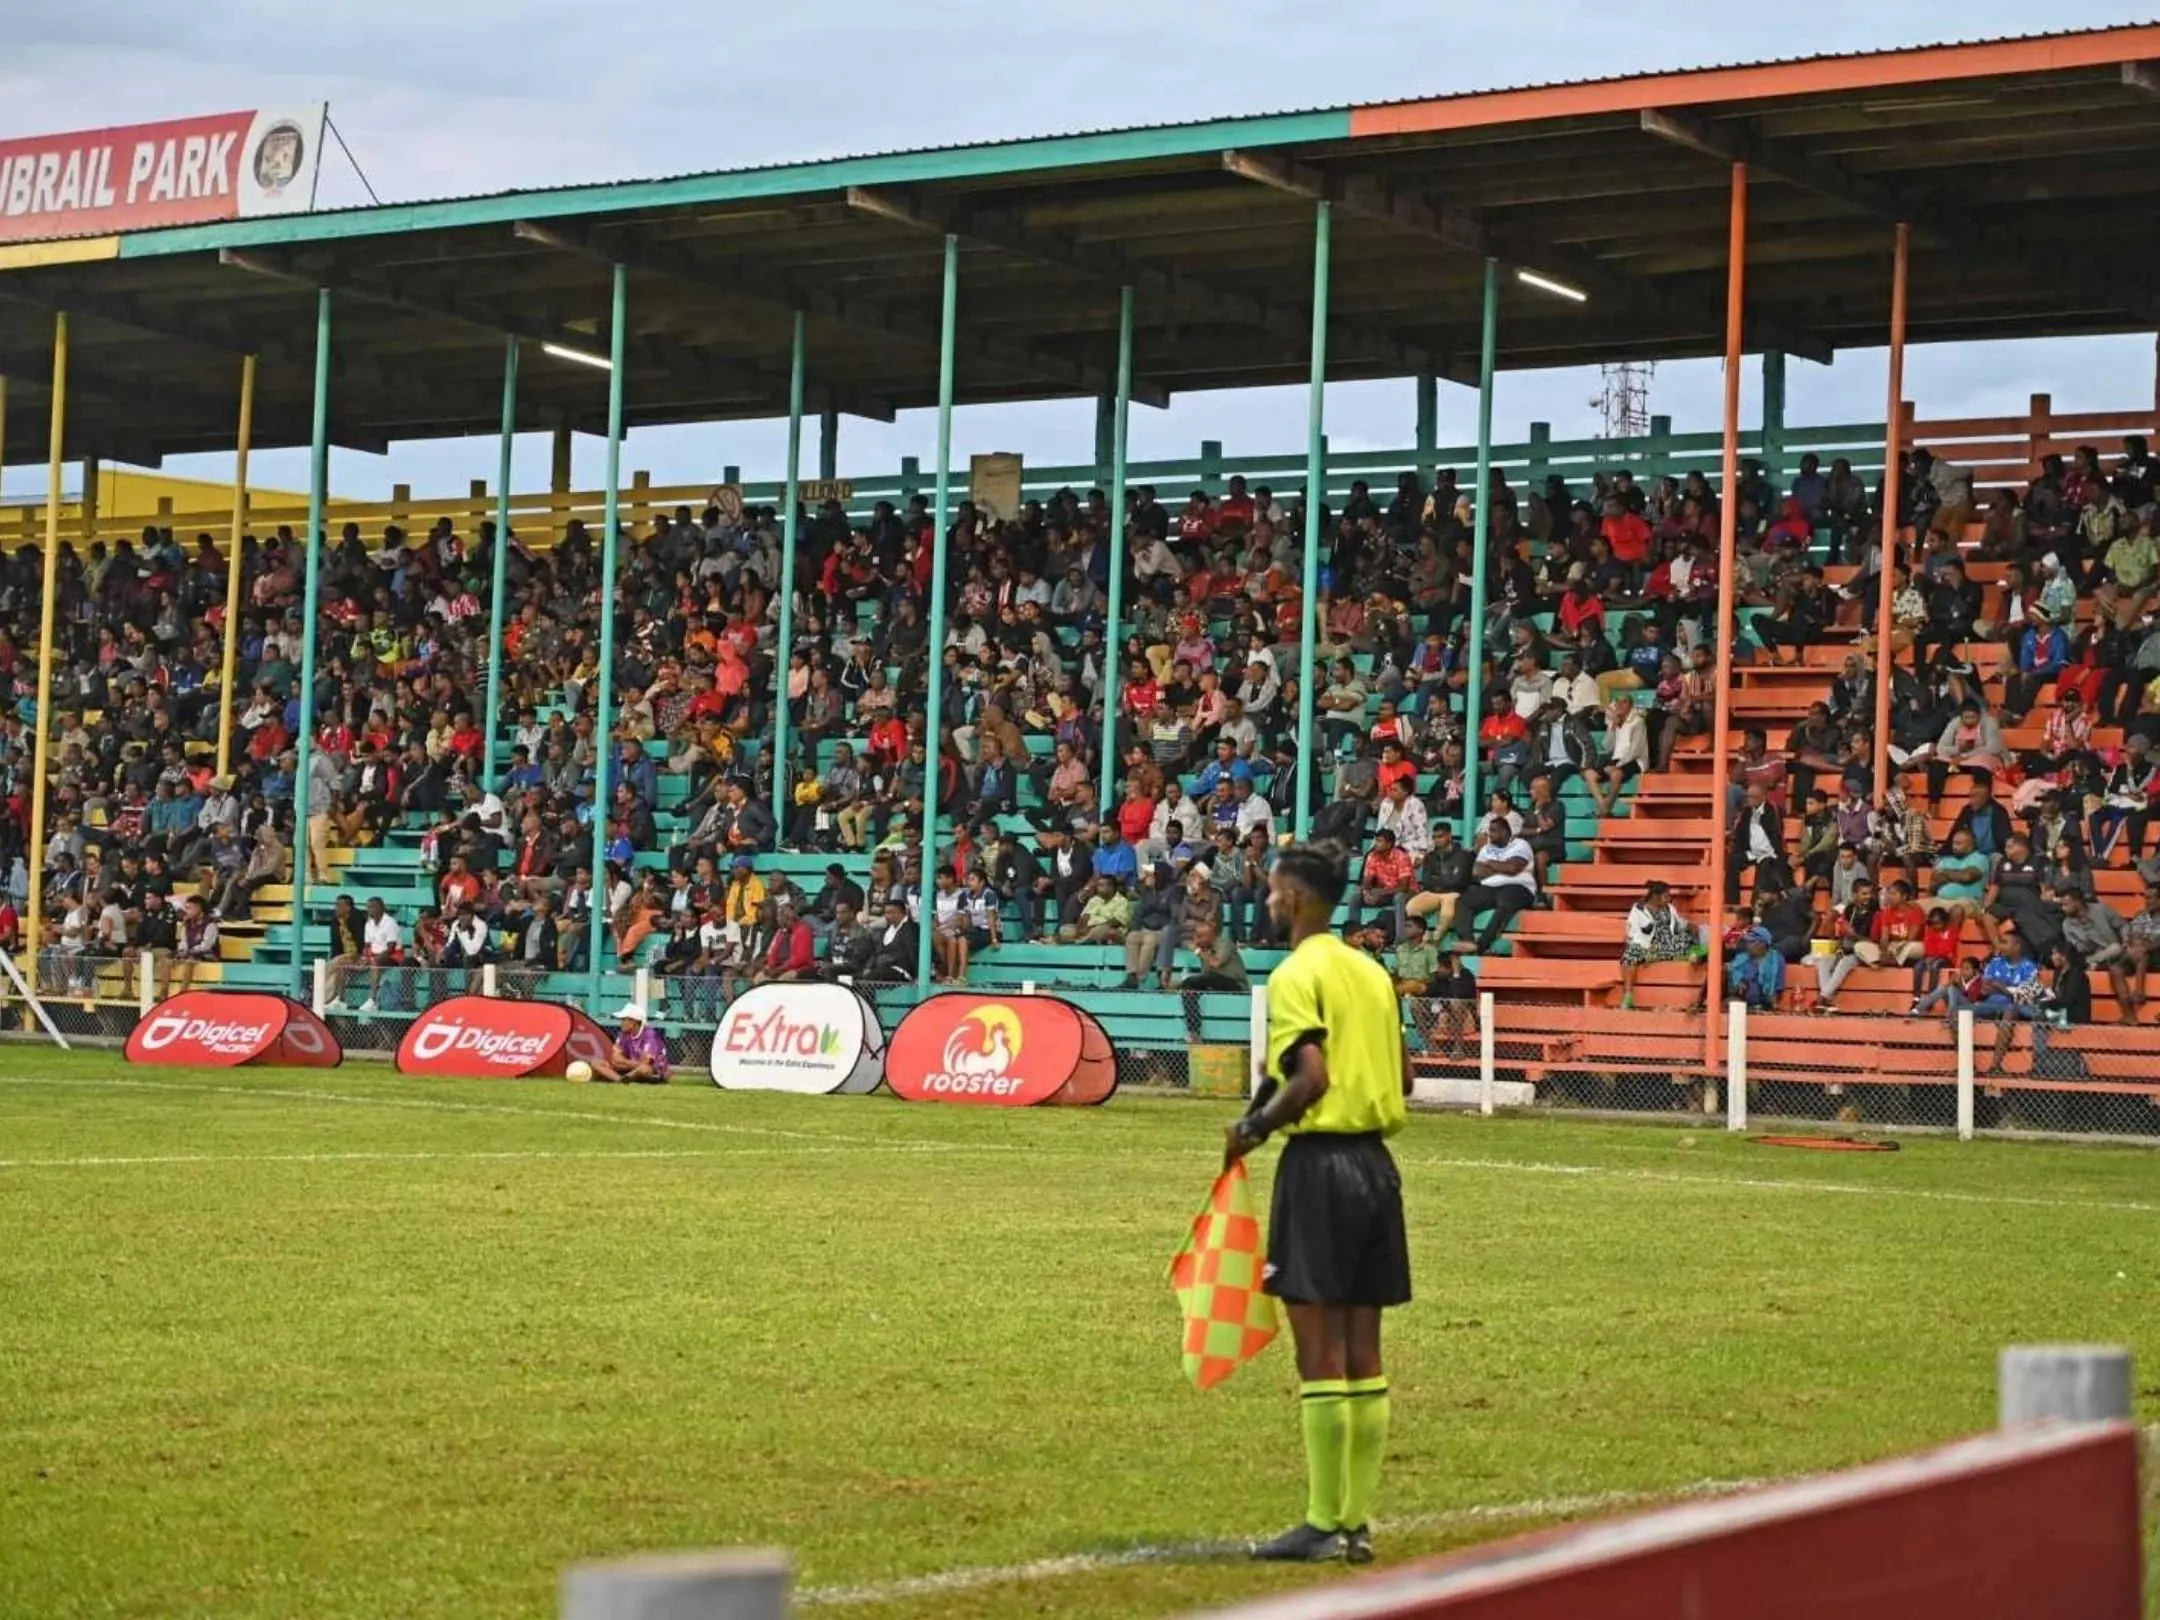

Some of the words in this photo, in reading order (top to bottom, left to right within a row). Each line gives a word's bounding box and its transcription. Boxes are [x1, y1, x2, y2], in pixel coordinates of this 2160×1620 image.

[126, 132, 238, 203] PARK
[180, 1018, 271, 1047] Digicel
[455, 1026, 552, 1057] Digicel
[725, 1003, 820, 1056] Extra
[922, 1069, 1024, 1096] rooster
